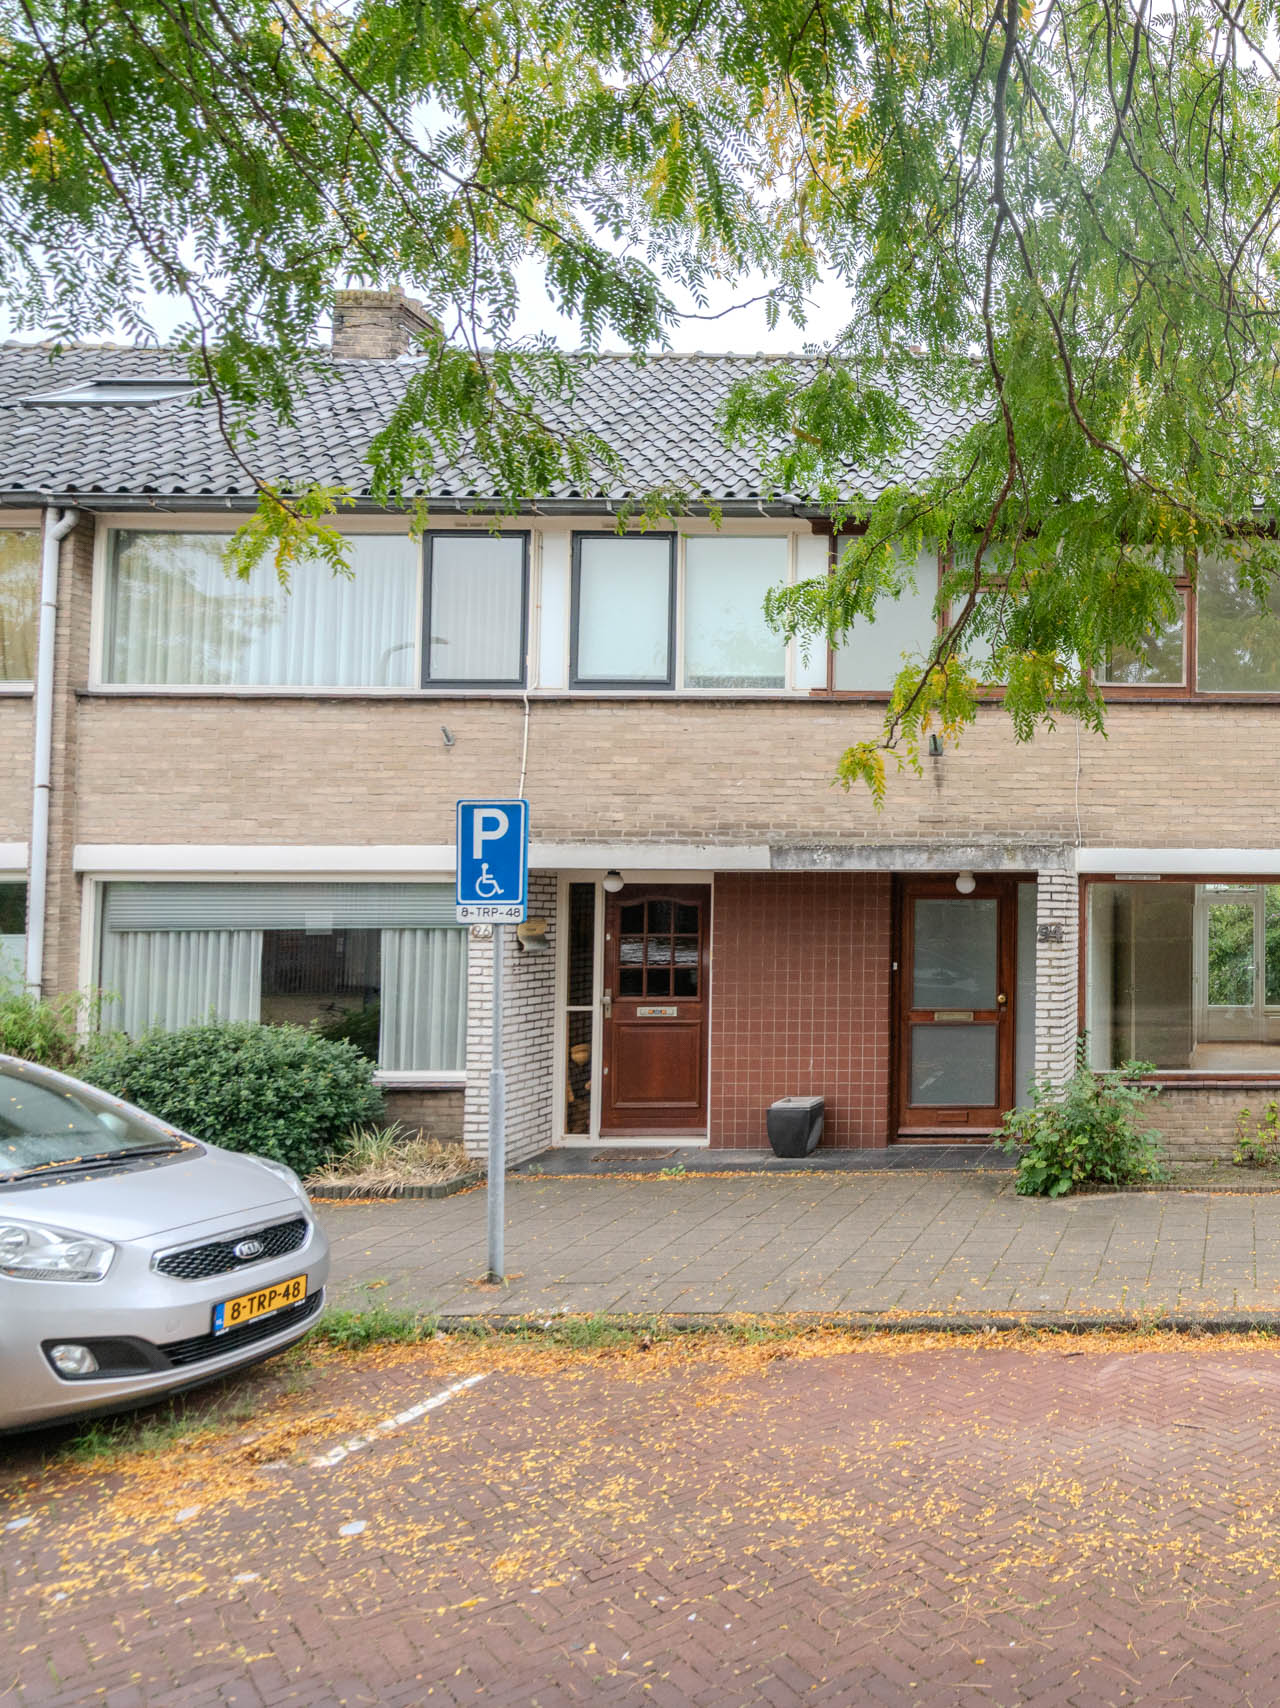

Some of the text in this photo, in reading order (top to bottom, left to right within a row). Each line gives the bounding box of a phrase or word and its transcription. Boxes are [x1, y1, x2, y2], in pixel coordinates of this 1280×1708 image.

[473, 808, 509, 859] P
[461, 907, 520, 918] 8-TRP-48
[1038, 922, 1064, 944] 94
[240, 1241, 261, 1256] KIA
[230, 1281, 301, 1321] 8-TRP-48
